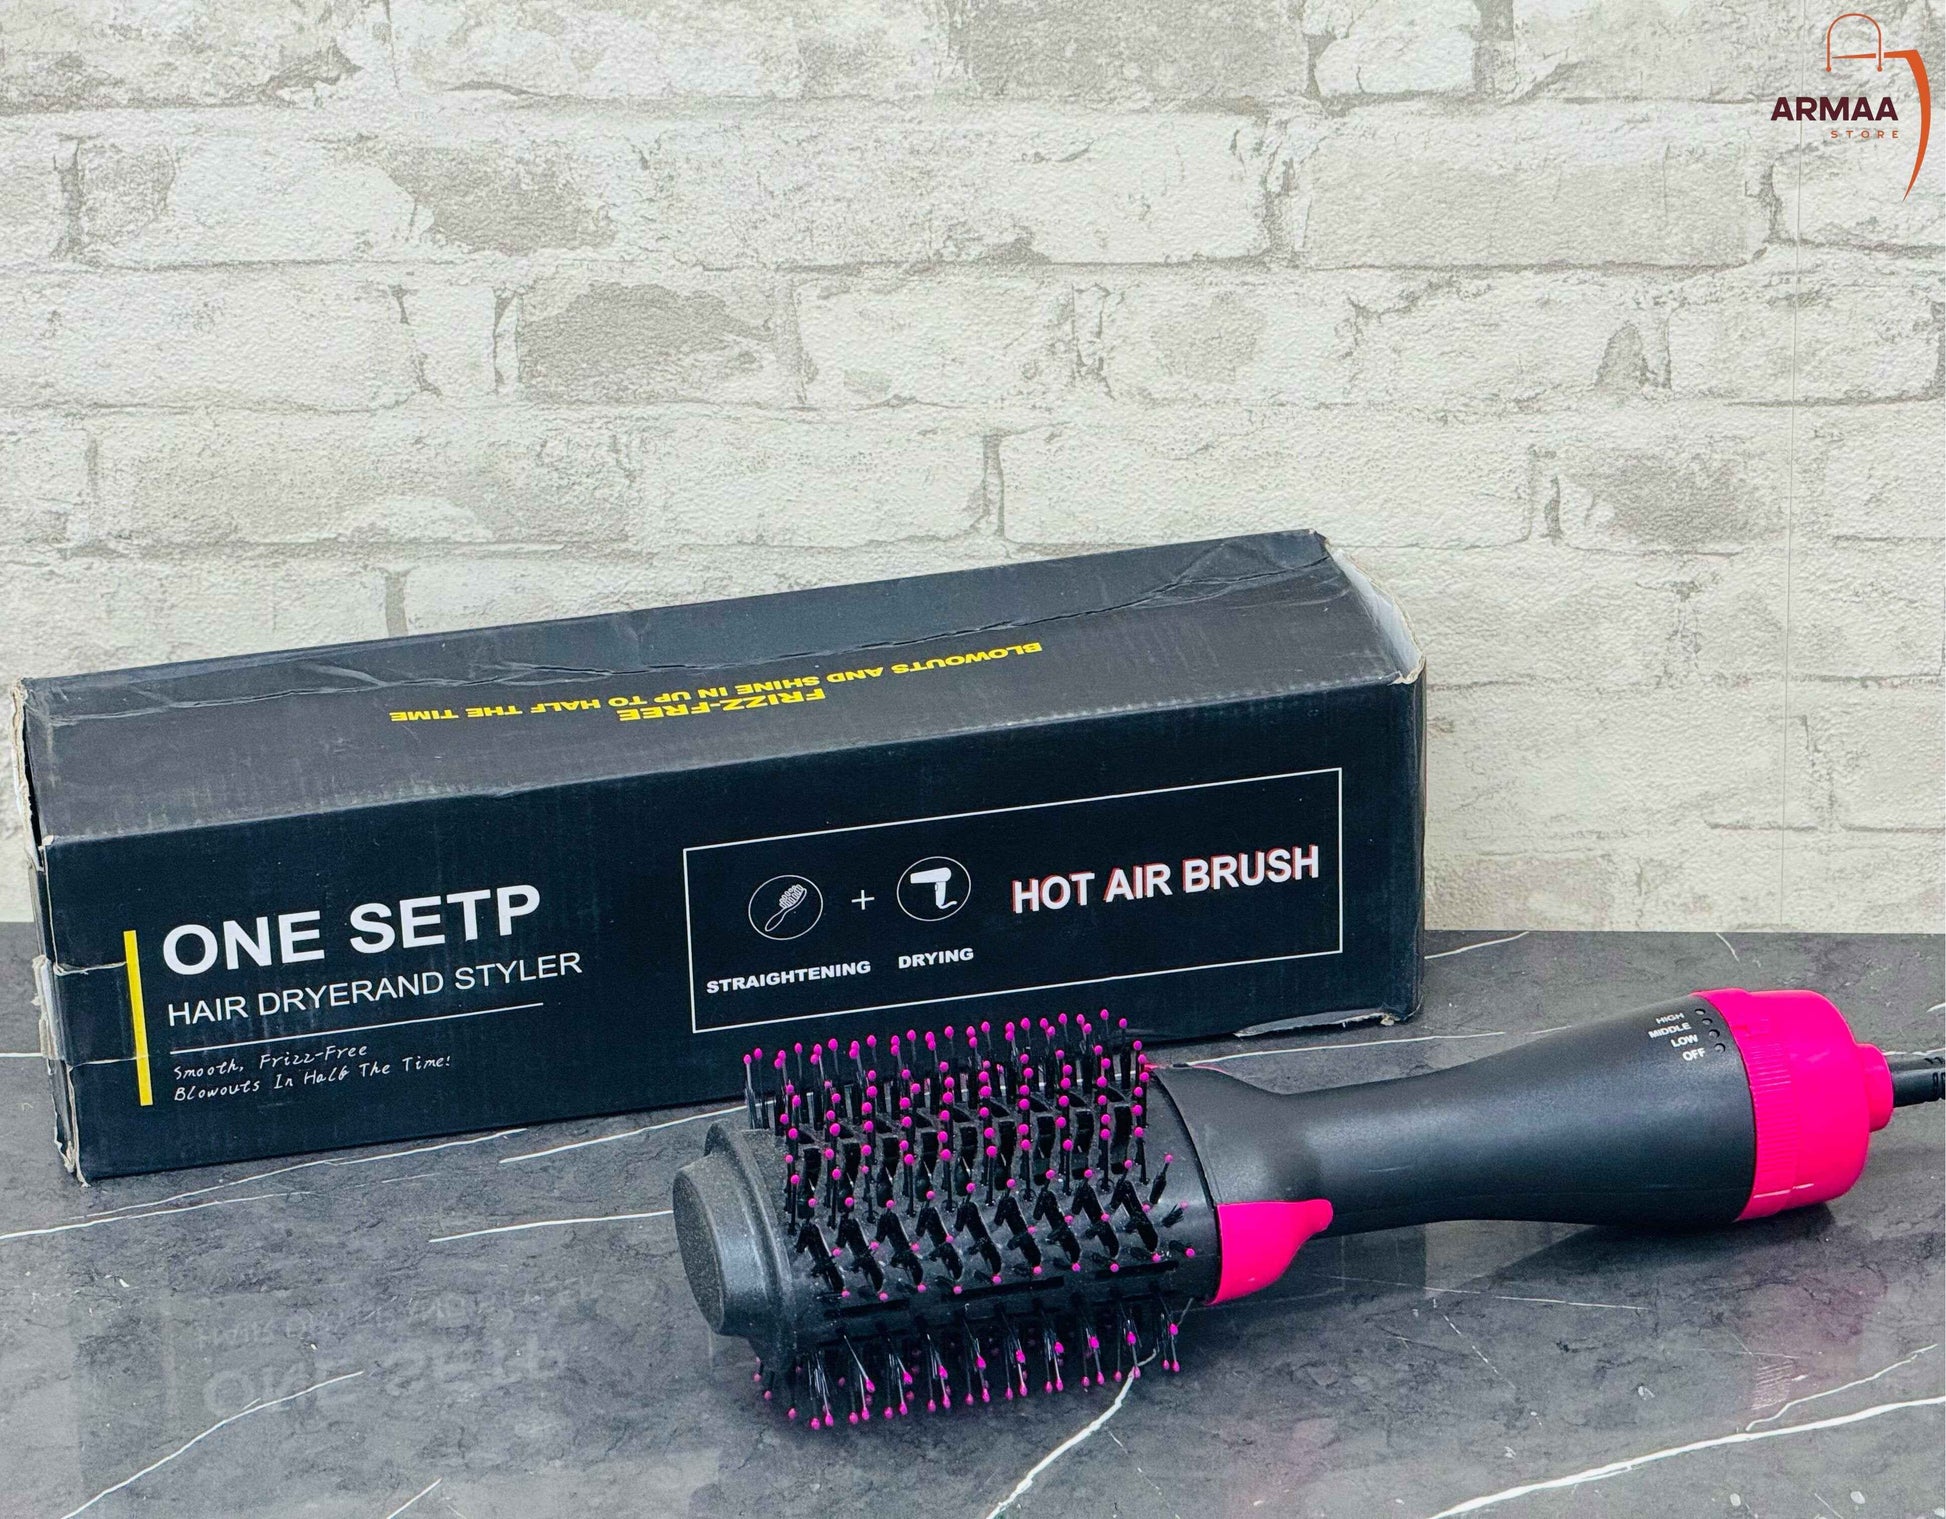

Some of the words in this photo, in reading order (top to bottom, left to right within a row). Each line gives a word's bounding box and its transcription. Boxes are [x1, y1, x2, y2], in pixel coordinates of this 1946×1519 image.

[890, 641, 1042, 676] BLOWOUTS
[825, 666, 884, 683] AND
[696, 687, 728, 698] IN
[735, 675, 820, 695] SHINE
[607, 696, 646, 707] TO
[617, 687, 827, 721] FRIZZ-FREE
[655, 690, 690, 702] UP
[464, 703, 524, 717] THE
[531, 698, 602, 713] HALF
[388, 707, 457, 722] TIME
[1011, 872, 1096, 914] HOT
[1103, 862, 1173, 903] AIR
[1182, 845, 1319, 894] BRUSH
[162, 910, 325, 976] ONE
[349, 884, 541, 954] SETP
[898, 947, 975, 969] DRYING
[706, 960, 872, 994] STRAIGHTENING
[168, 996, 249, 1027] HAIR
[258, 971, 444, 1016] DRYERAND
[455, 952, 583, 991] STYLER
[1655, 1012, 1685, 1025] HIGH
[1648, 1022, 1692, 1039] MIDDLE
[1670, 1034, 1699, 1048] LOW
[173, 1058, 244, 1080] Smooth,
[259, 1045, 367, 1070] Frizz-Free
[1682, 1047, 1706, 1062] OFF
[174, 1080, 260, 1102] Blowouts
[273, 1073, 294, 1089] In
[303, 1065, 349, 1085] Half
[358, 1061, 391, 1077] The
[402, 1055, 451, 1072] Time!
